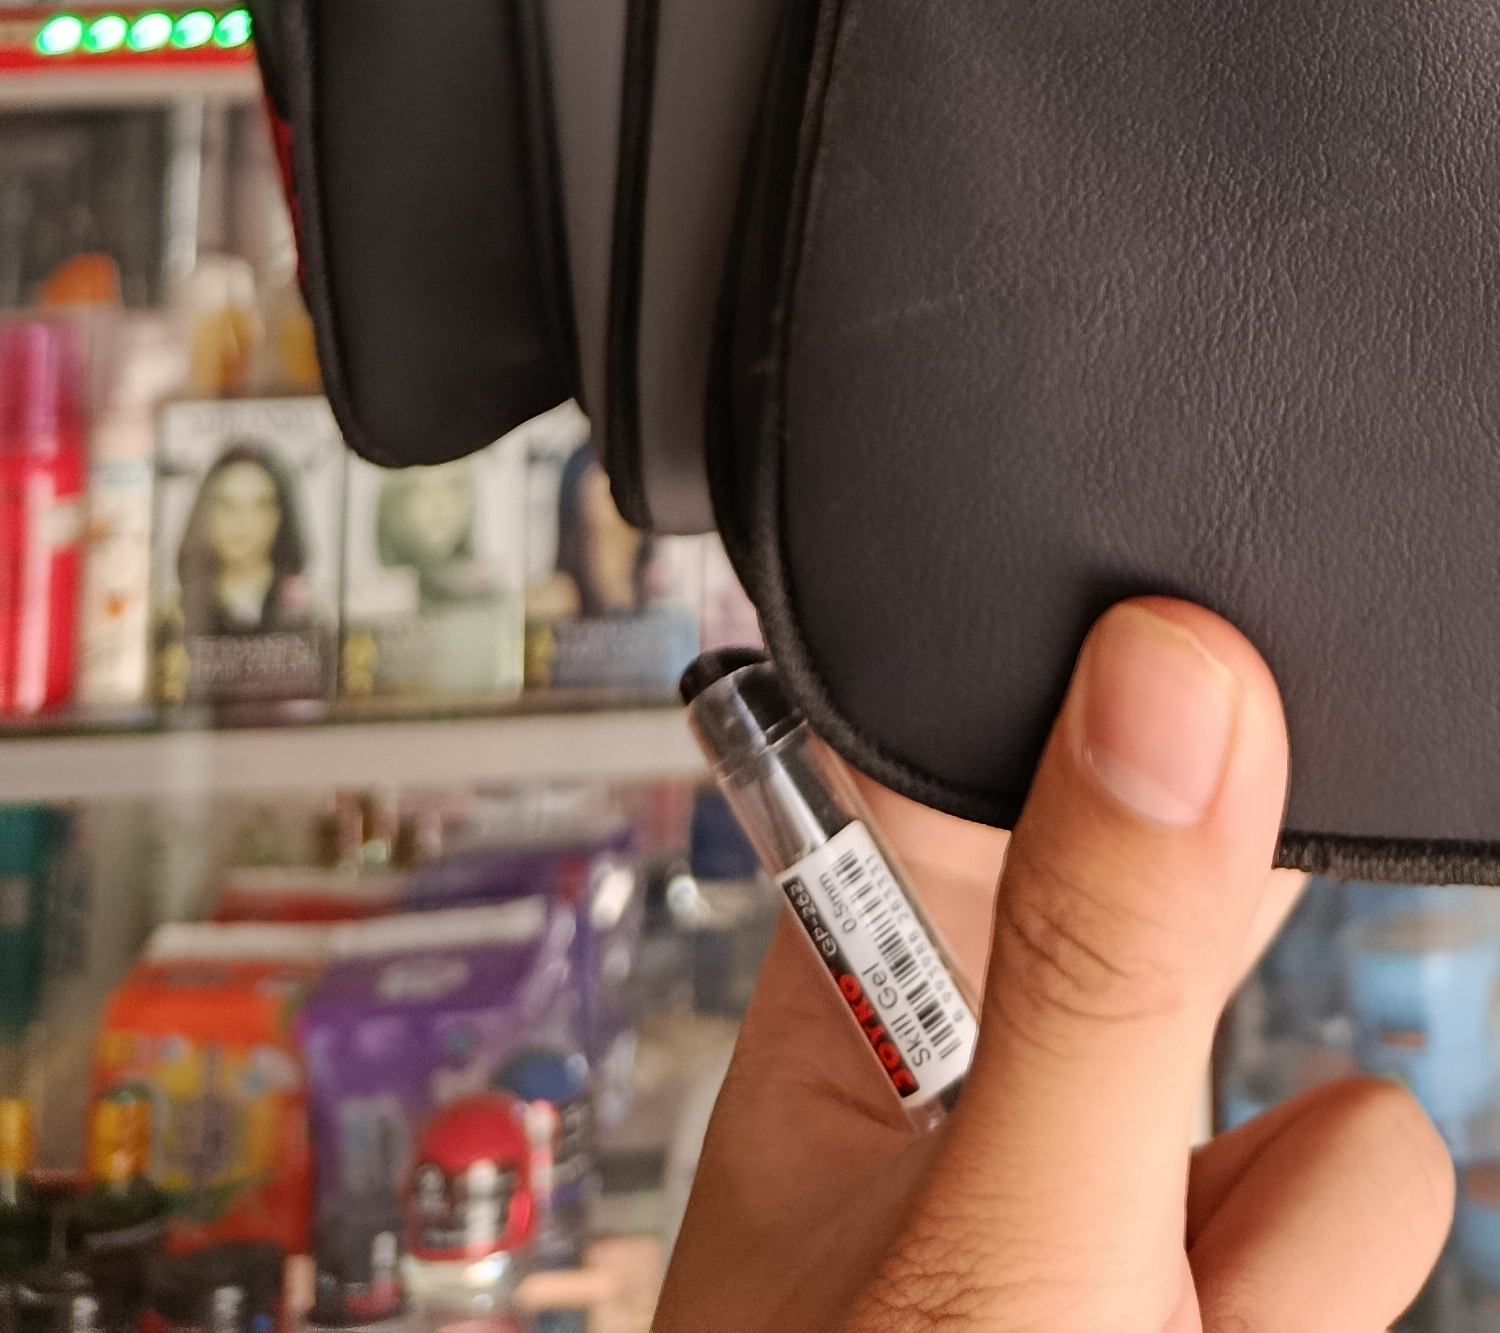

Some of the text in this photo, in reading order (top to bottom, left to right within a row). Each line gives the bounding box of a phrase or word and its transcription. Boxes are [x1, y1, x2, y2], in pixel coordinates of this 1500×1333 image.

[817, 871, 858, 935] 0.5mm
[787, 880, 916, 1091] JOYKO GP-262
[860, 962, 932, 1068] Skill Gel
